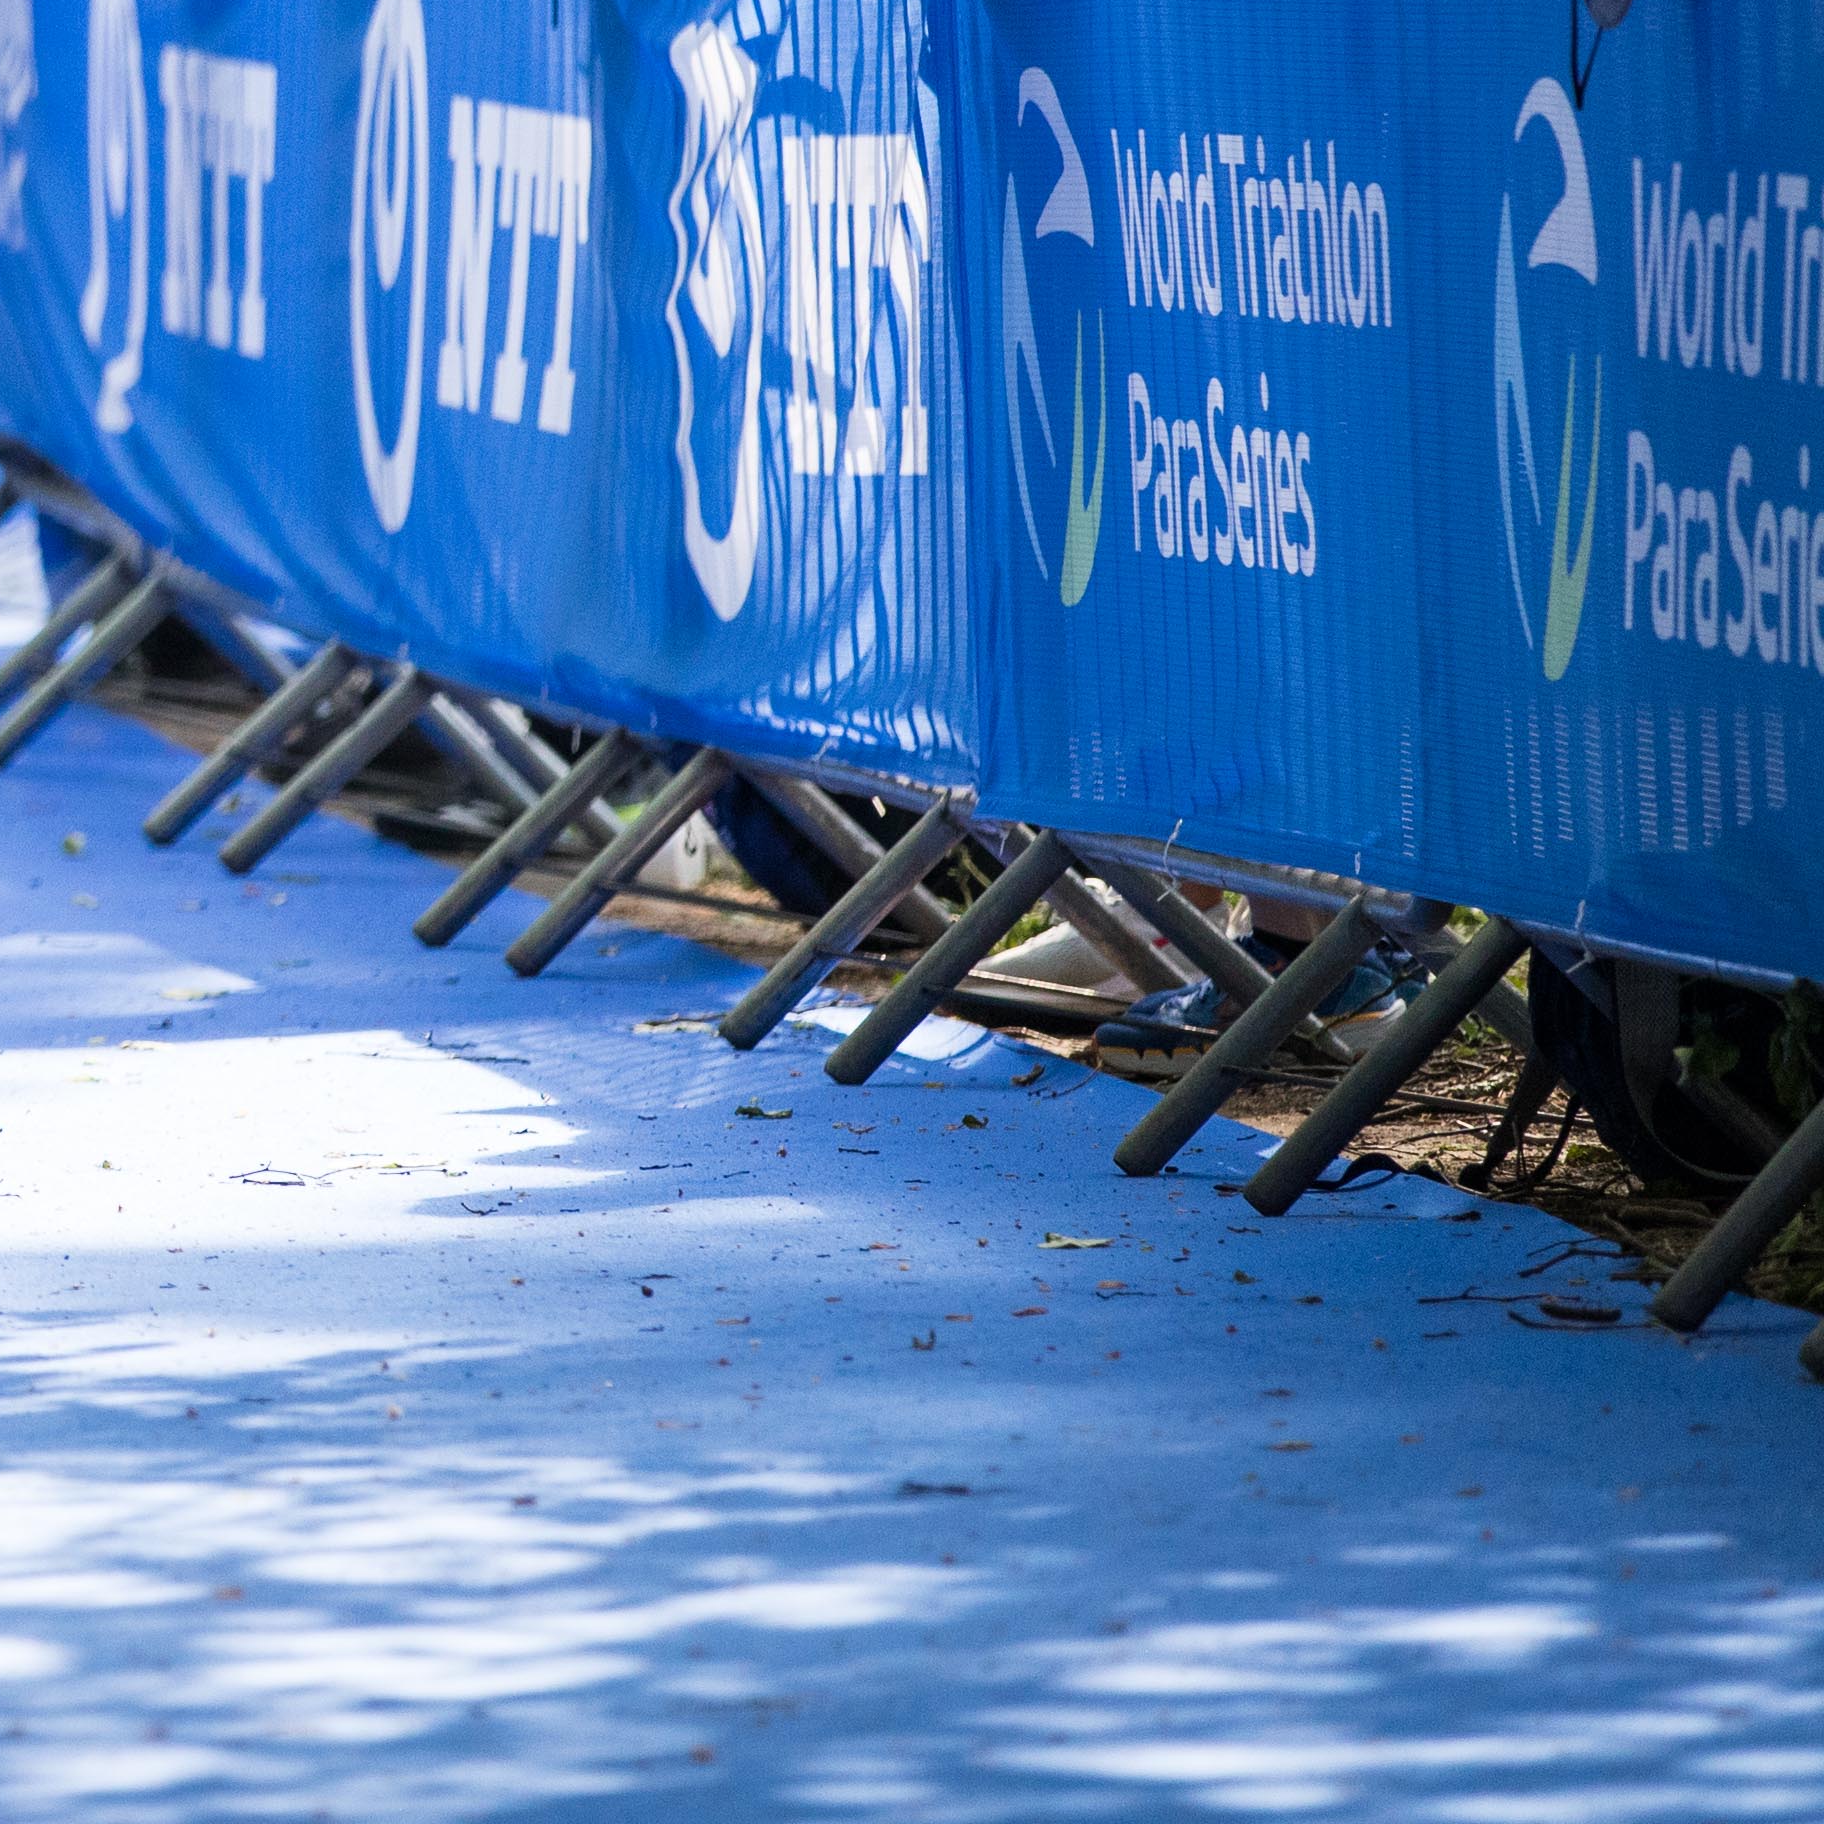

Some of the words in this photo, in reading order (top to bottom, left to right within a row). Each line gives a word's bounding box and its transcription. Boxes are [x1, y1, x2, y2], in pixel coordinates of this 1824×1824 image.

[437, 95, 592, 436] NTT
[782, 134, 931, 476] NTT
[1111, 128, 1223, 317] World
[1217, 134, 1392, 329] Triathlon
[1633, 157, 1768, 378] World
